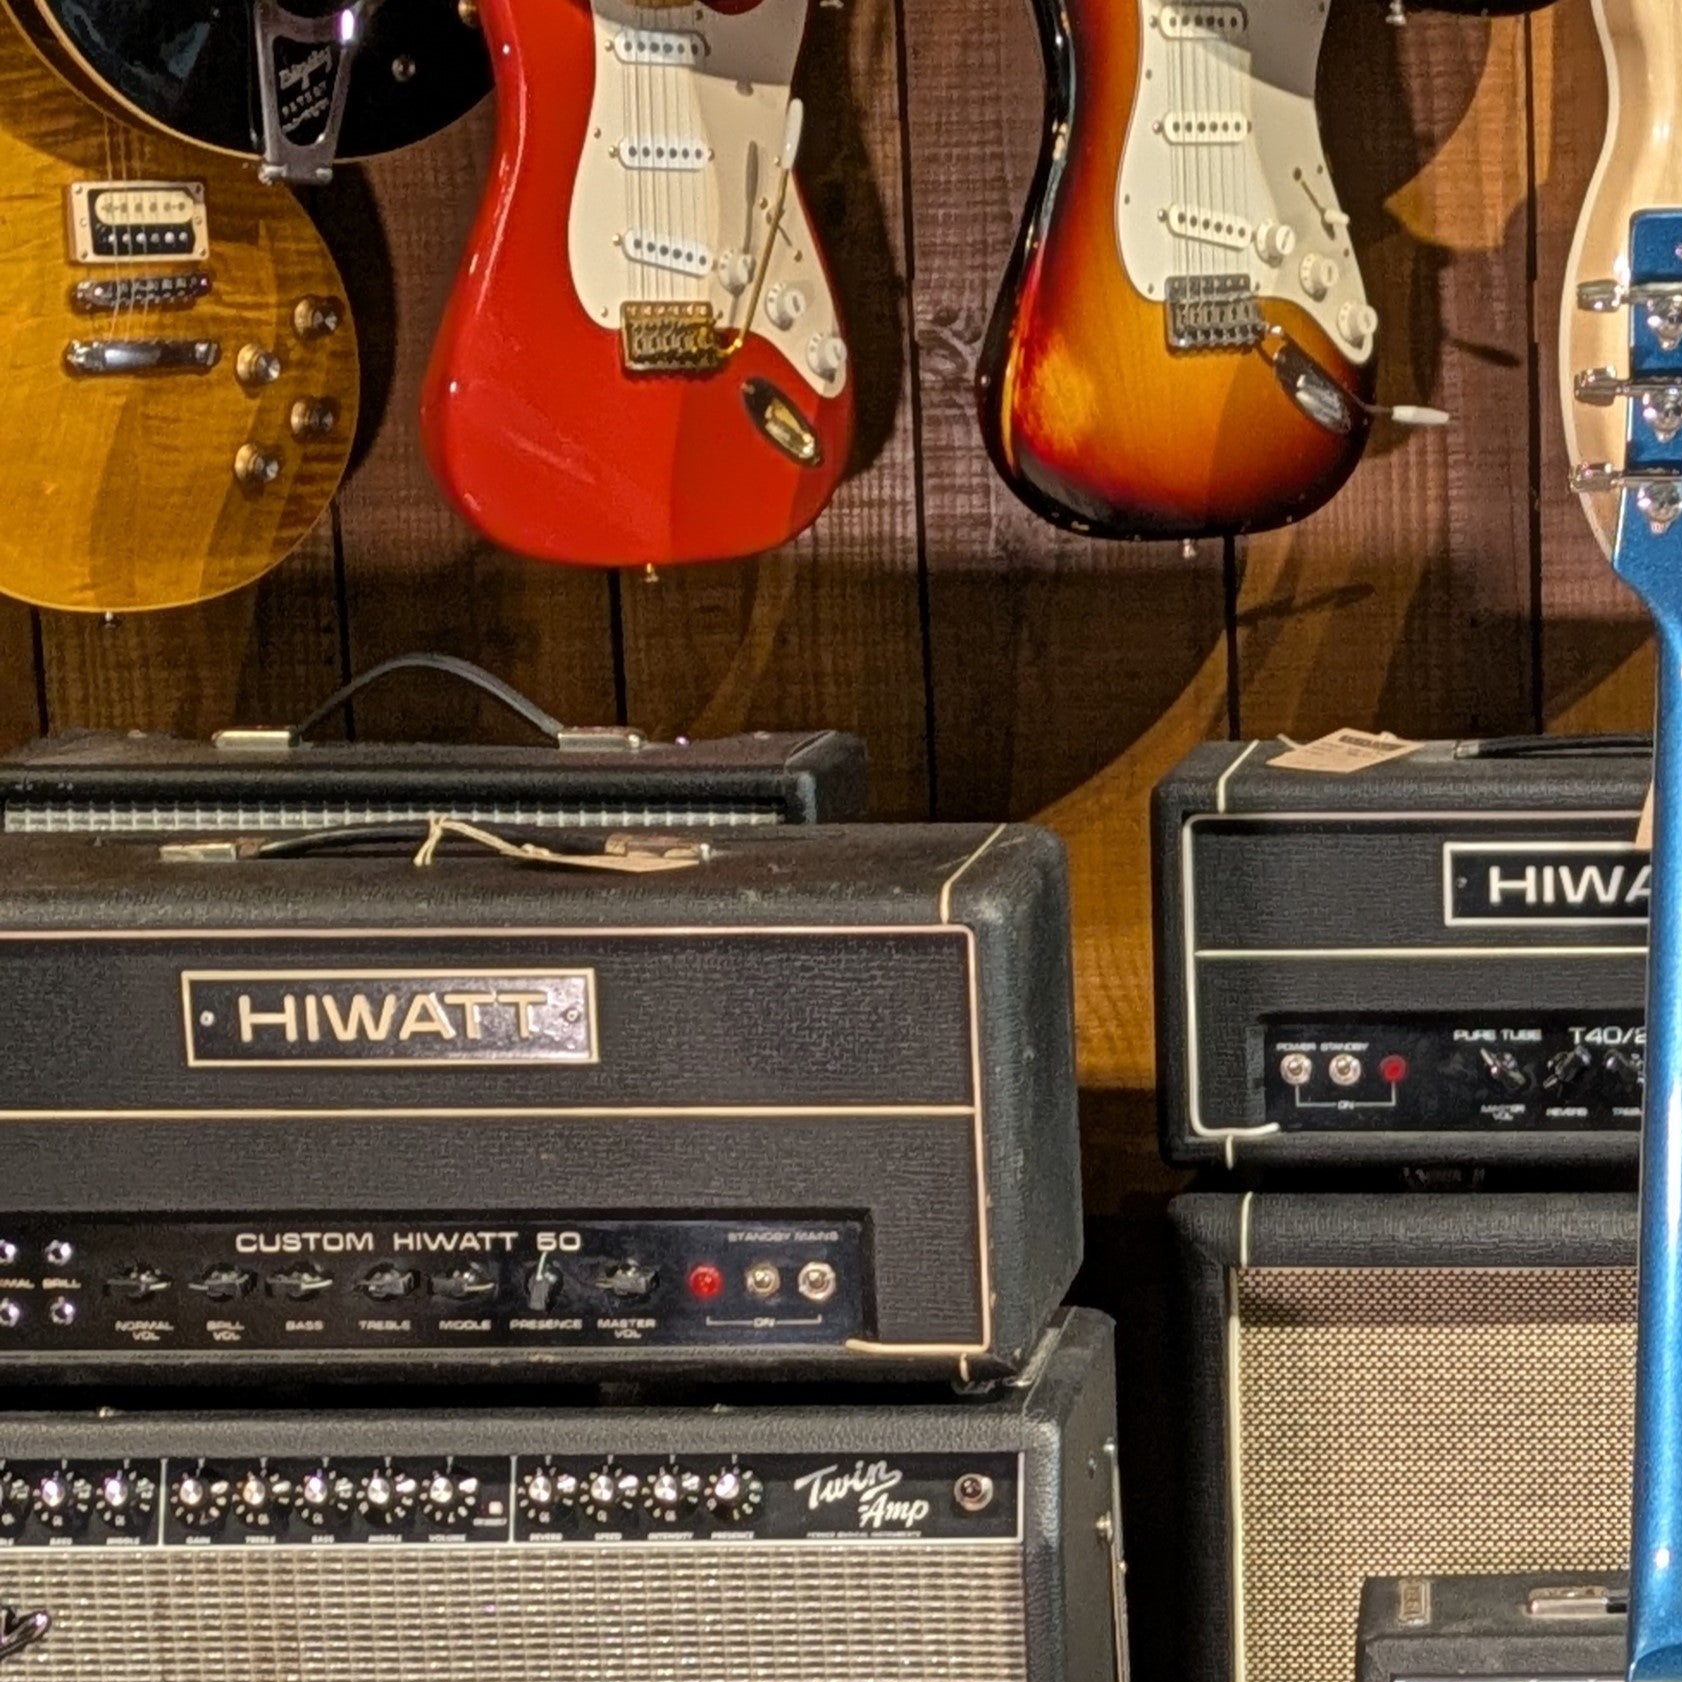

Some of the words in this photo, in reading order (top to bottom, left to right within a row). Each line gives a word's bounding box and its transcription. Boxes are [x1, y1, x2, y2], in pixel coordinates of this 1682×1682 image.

[1488, 865, 1651, 905] HIWA
[238, 990, 549, 1042] HIWATT
[1453, 1028, 1497, 1042] PURE
[1502, 1028, 1542, 1042] TUBE
[235, 1232, 374, 1253] CUSTOM
[393, 1231, 519, 1252] HIWATT
[536, 1231, 582, 1251] 50
[728, 1231, 791, 1243] STANDBY
[794, 1231, 839, 1242] MAINS
[115, 1320, 174, 1332] NORMAL
[285, 1320, 325, 1331] BASS
[358, 1320, 411, 1331] TREBLE
[438, 1320, 491, 1331] MIDDLE
[509, 1319, 583, 1331] PRESENCE
[597, 1318, 656, 1329] MASTER
[753, 1316, 776, 1328] ON
[132, 1331, 160, 1342] VOL
[213, 1331, 241, 1342] VOL
[614, 1328, 643, 1339] VOL
[794, 1460, 903, 1510] Twin
[858, 1493, 930, 1528] Amp
